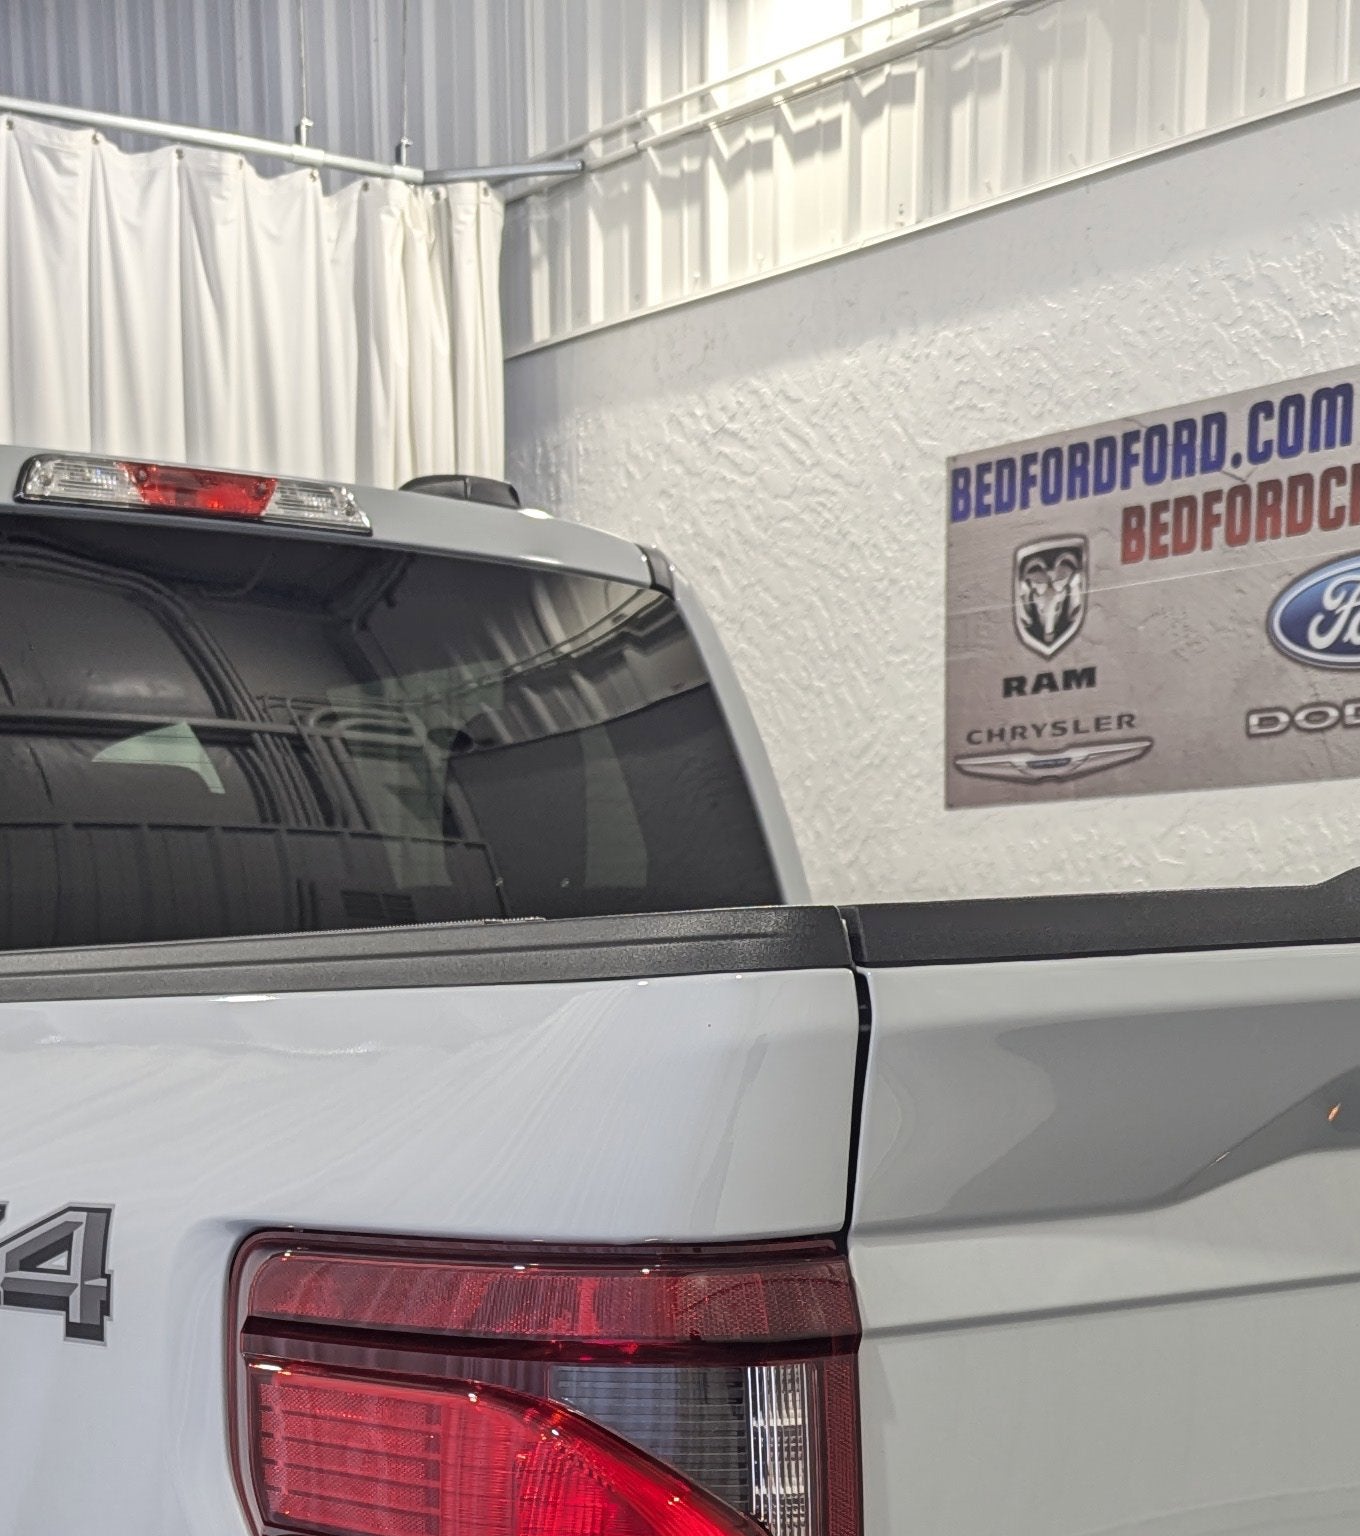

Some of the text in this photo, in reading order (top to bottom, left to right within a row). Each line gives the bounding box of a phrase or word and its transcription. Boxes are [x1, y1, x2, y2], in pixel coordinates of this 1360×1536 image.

[950, 382, 1355, 524] BEDFORDFORD.COM
[1002, 666, 1097, 699] RAM
[965, 712, 1136, 746] CHRYSLER
